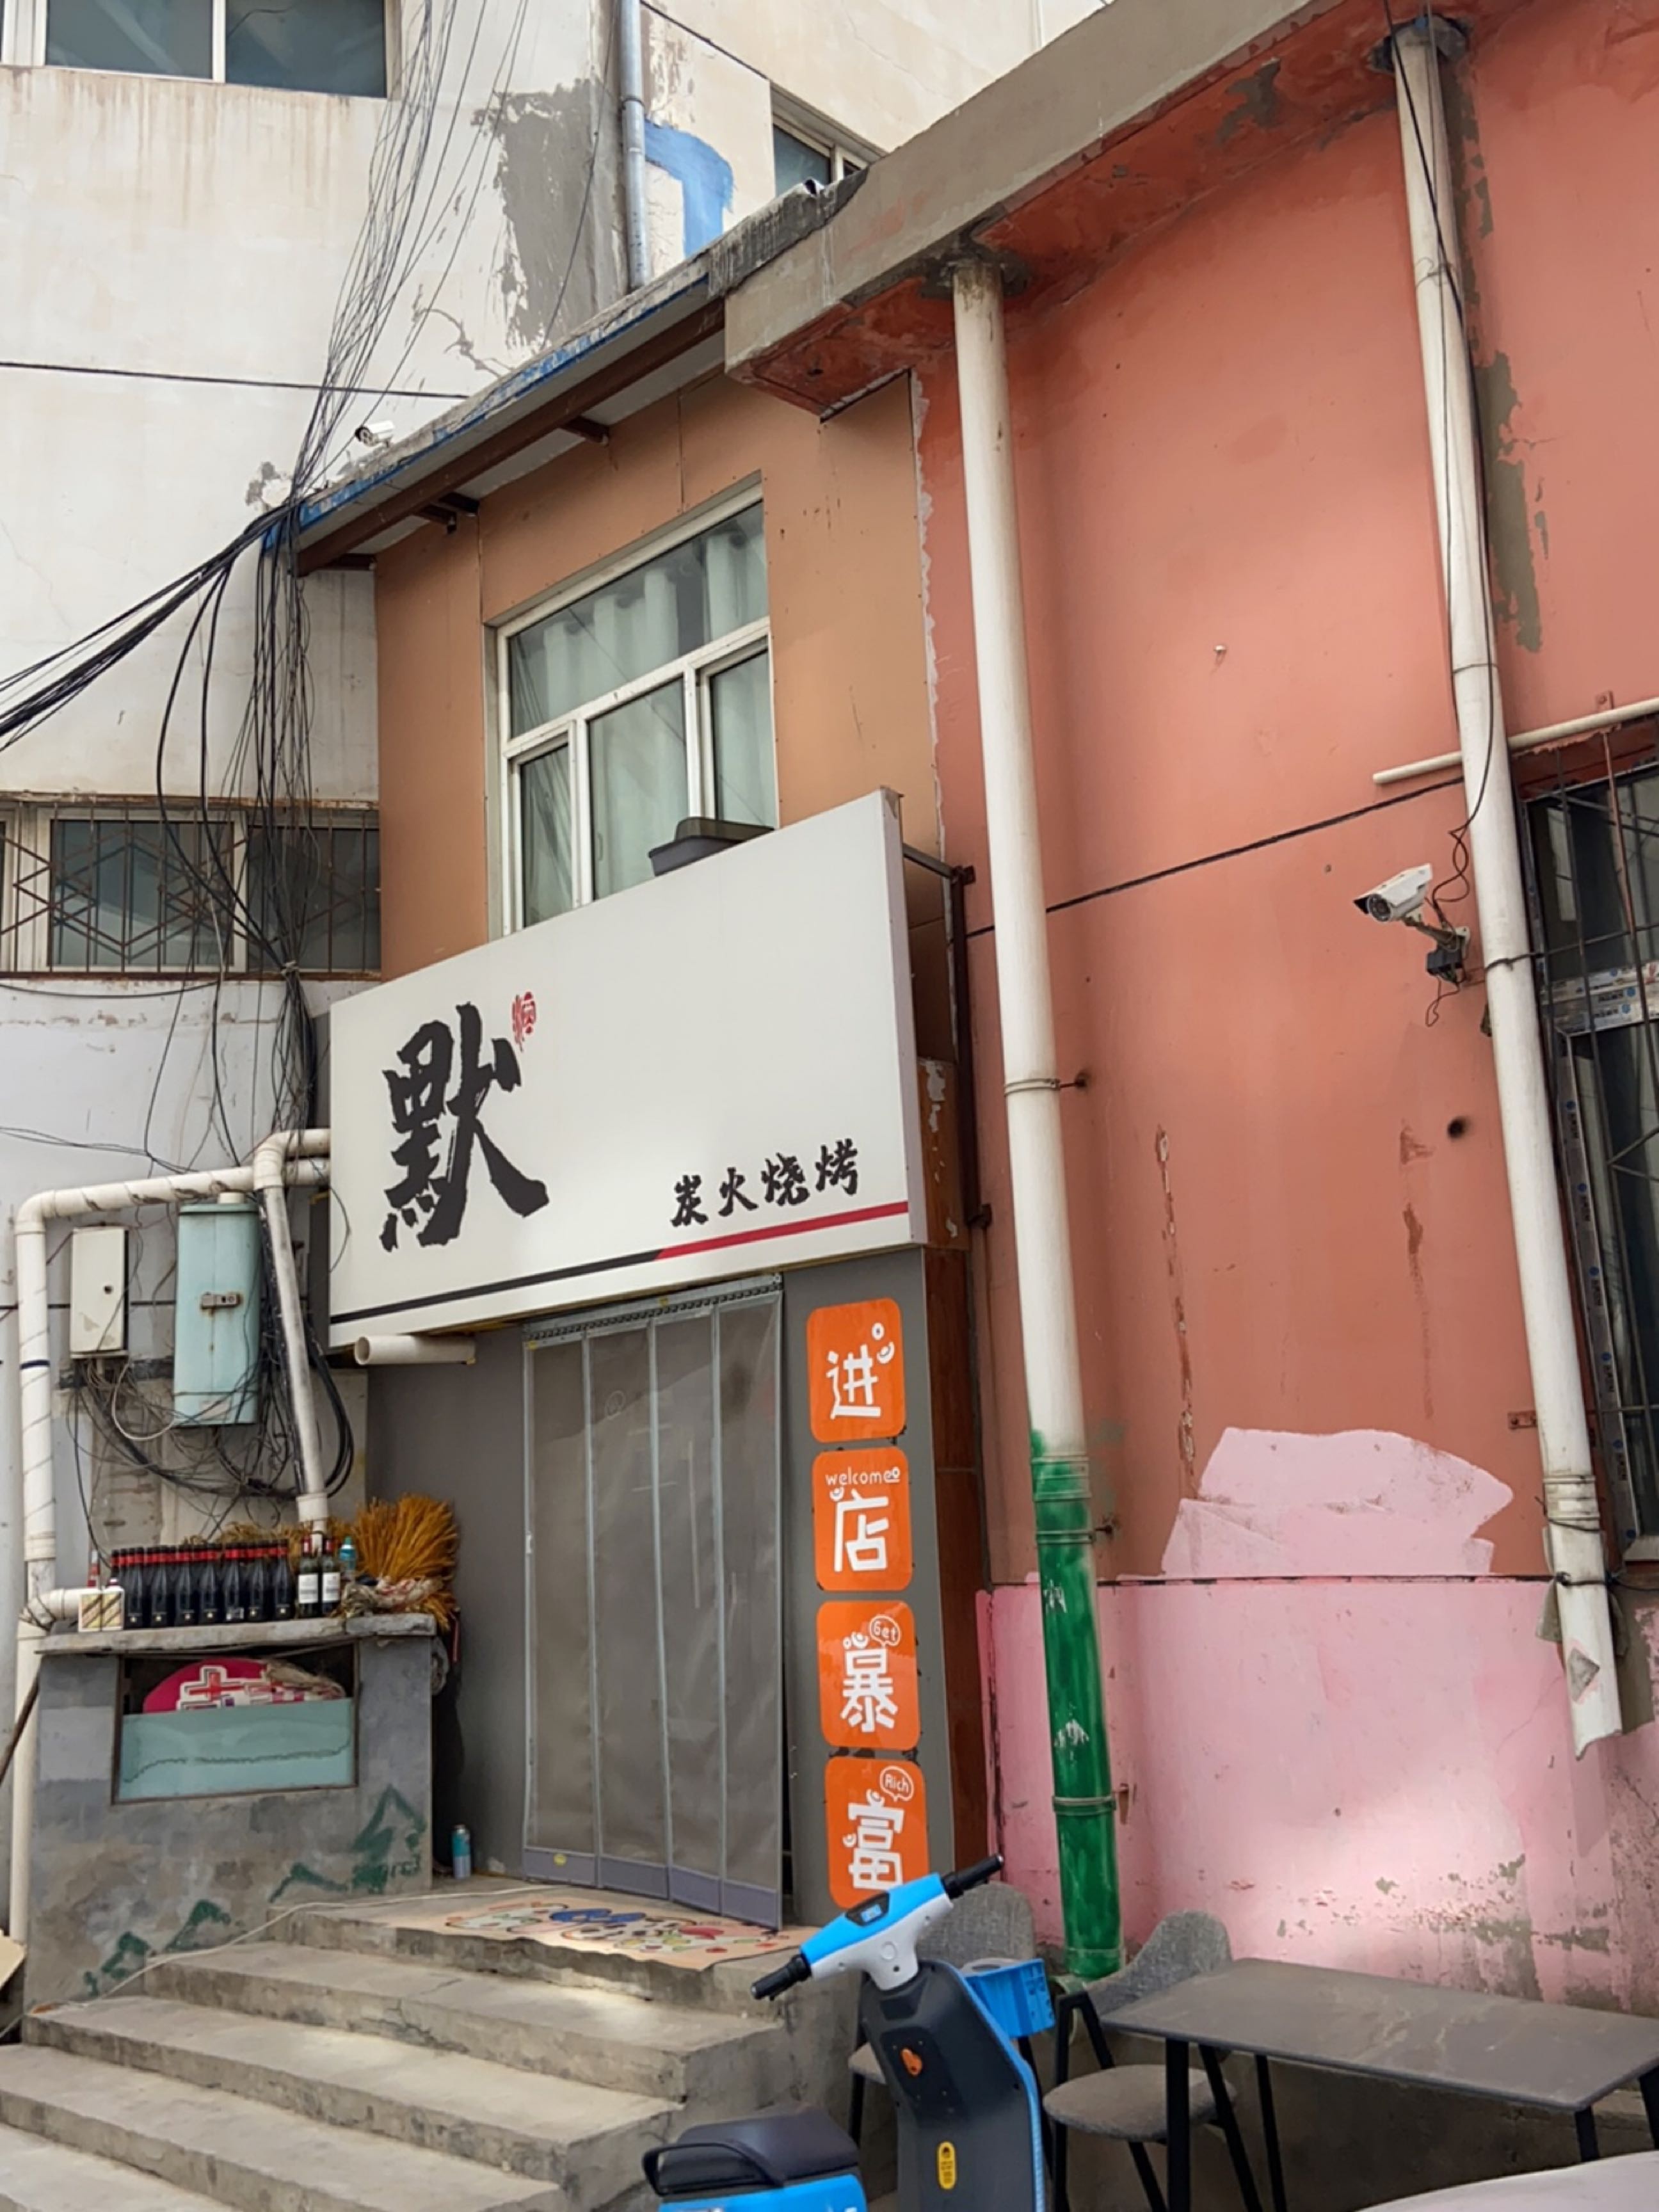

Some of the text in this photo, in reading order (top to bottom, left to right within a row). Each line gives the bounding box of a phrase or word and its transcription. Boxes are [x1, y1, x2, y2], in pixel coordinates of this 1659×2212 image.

[379, 1001, 550, 1253] 默
[671, 1138, 858, 1227] 炭火烧烤
[825, 1466, 901, 1486] welcome
[885, 1774, 910, 1794] Rich
